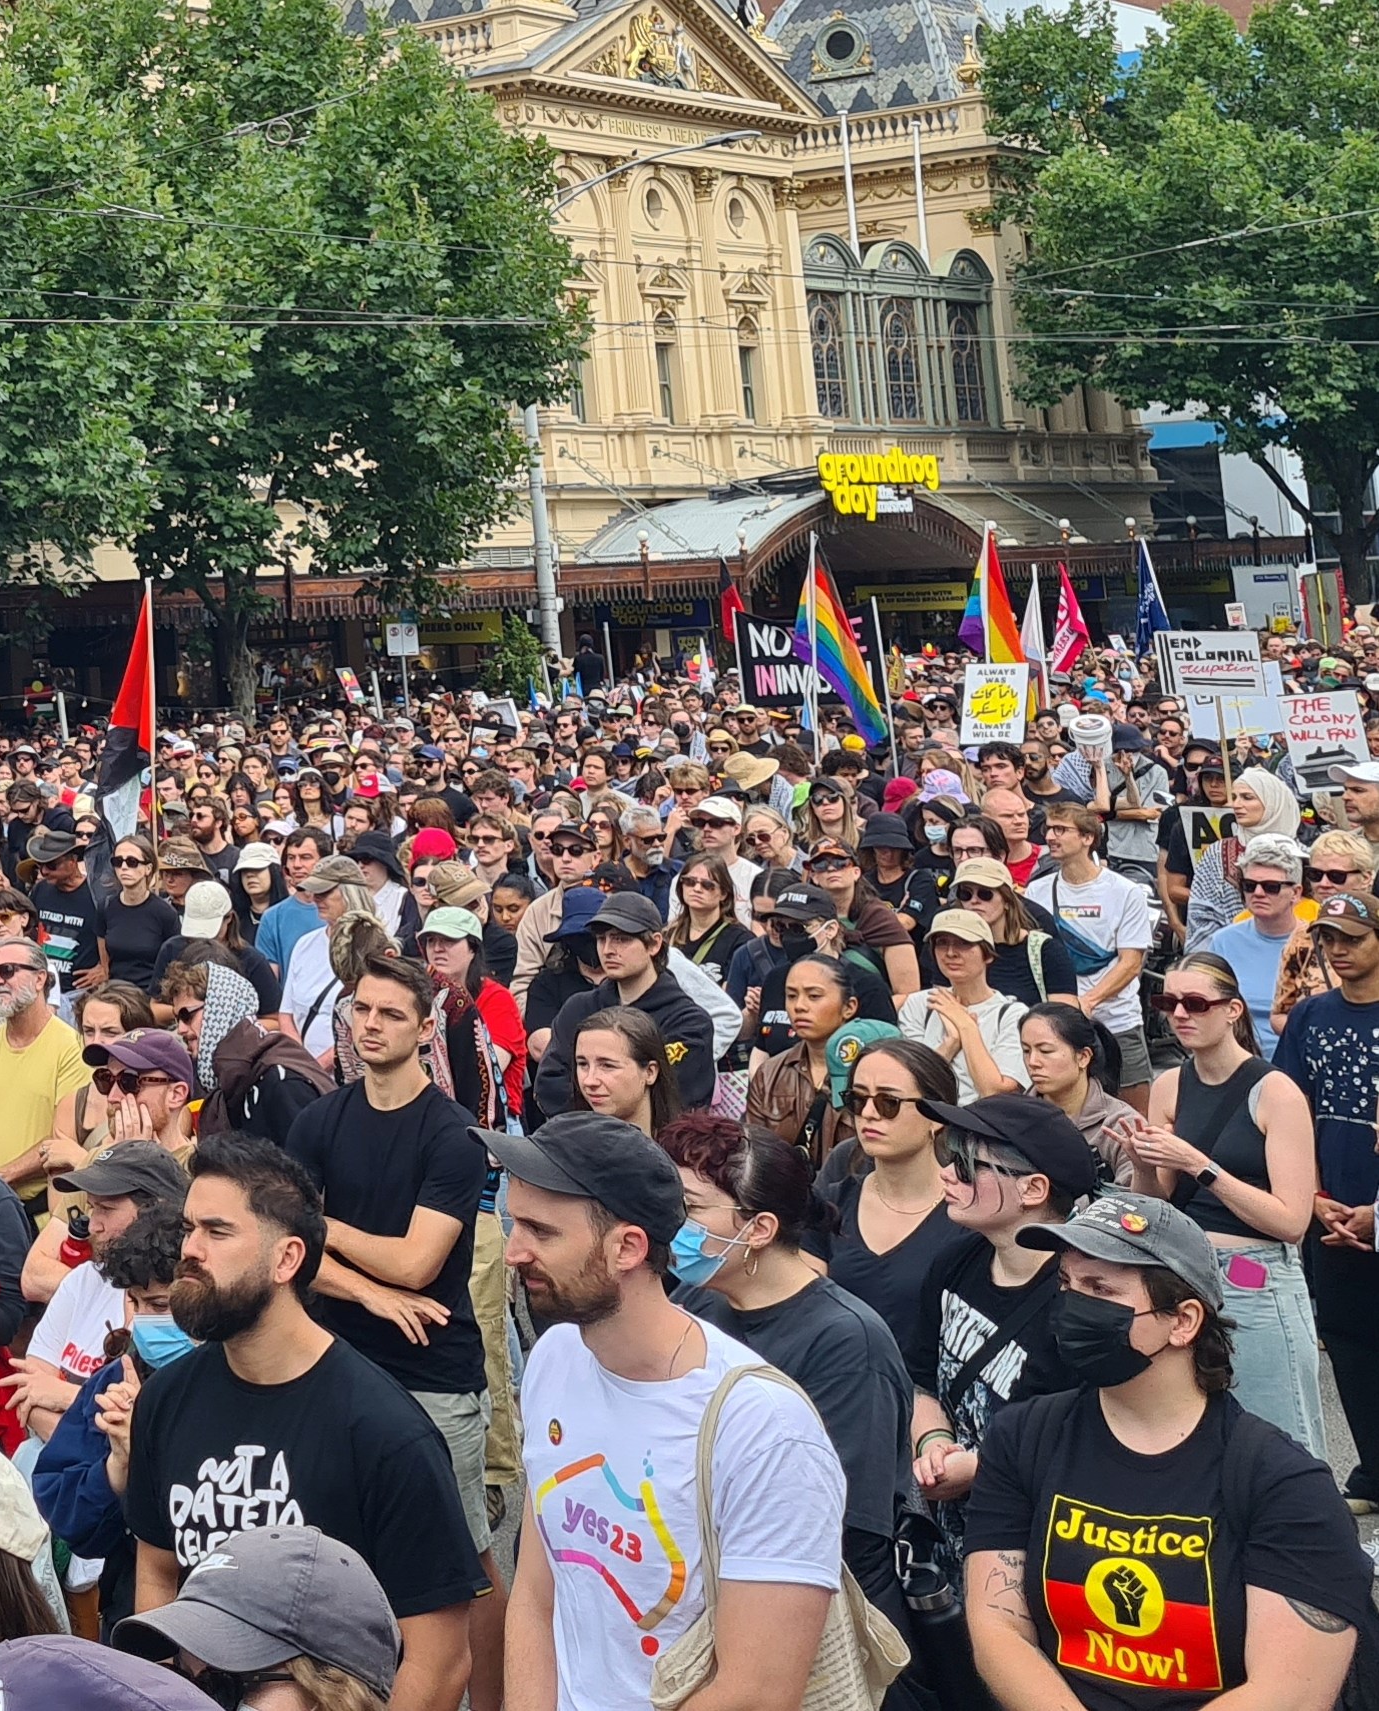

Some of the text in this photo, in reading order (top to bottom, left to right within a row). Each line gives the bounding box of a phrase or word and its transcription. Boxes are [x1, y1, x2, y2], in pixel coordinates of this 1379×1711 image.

[818, 447, 939, 491] groundhog
[832, 477, 877, 521] day
[454, 622, 484, 632] ONLY
[747, 622, 792, 658] NO
[1170, 636, 1202, 649] END
[1174, 650, 1259, 662] COLONIAL
[1282, 697, 1331, 714] THE
[1289, 714, 1356, 726] COLONY
[1327, 900, 1346, 915] 3
[197, 1445, 290, 1497] NOT A
[169, 1482, 304, 1530] DATE TO
[562, 1496, 642, 1563] yes23
[1055, 1508, 1205, 1558] Justice
[1084, 1629, 1188, 1683] Now!
